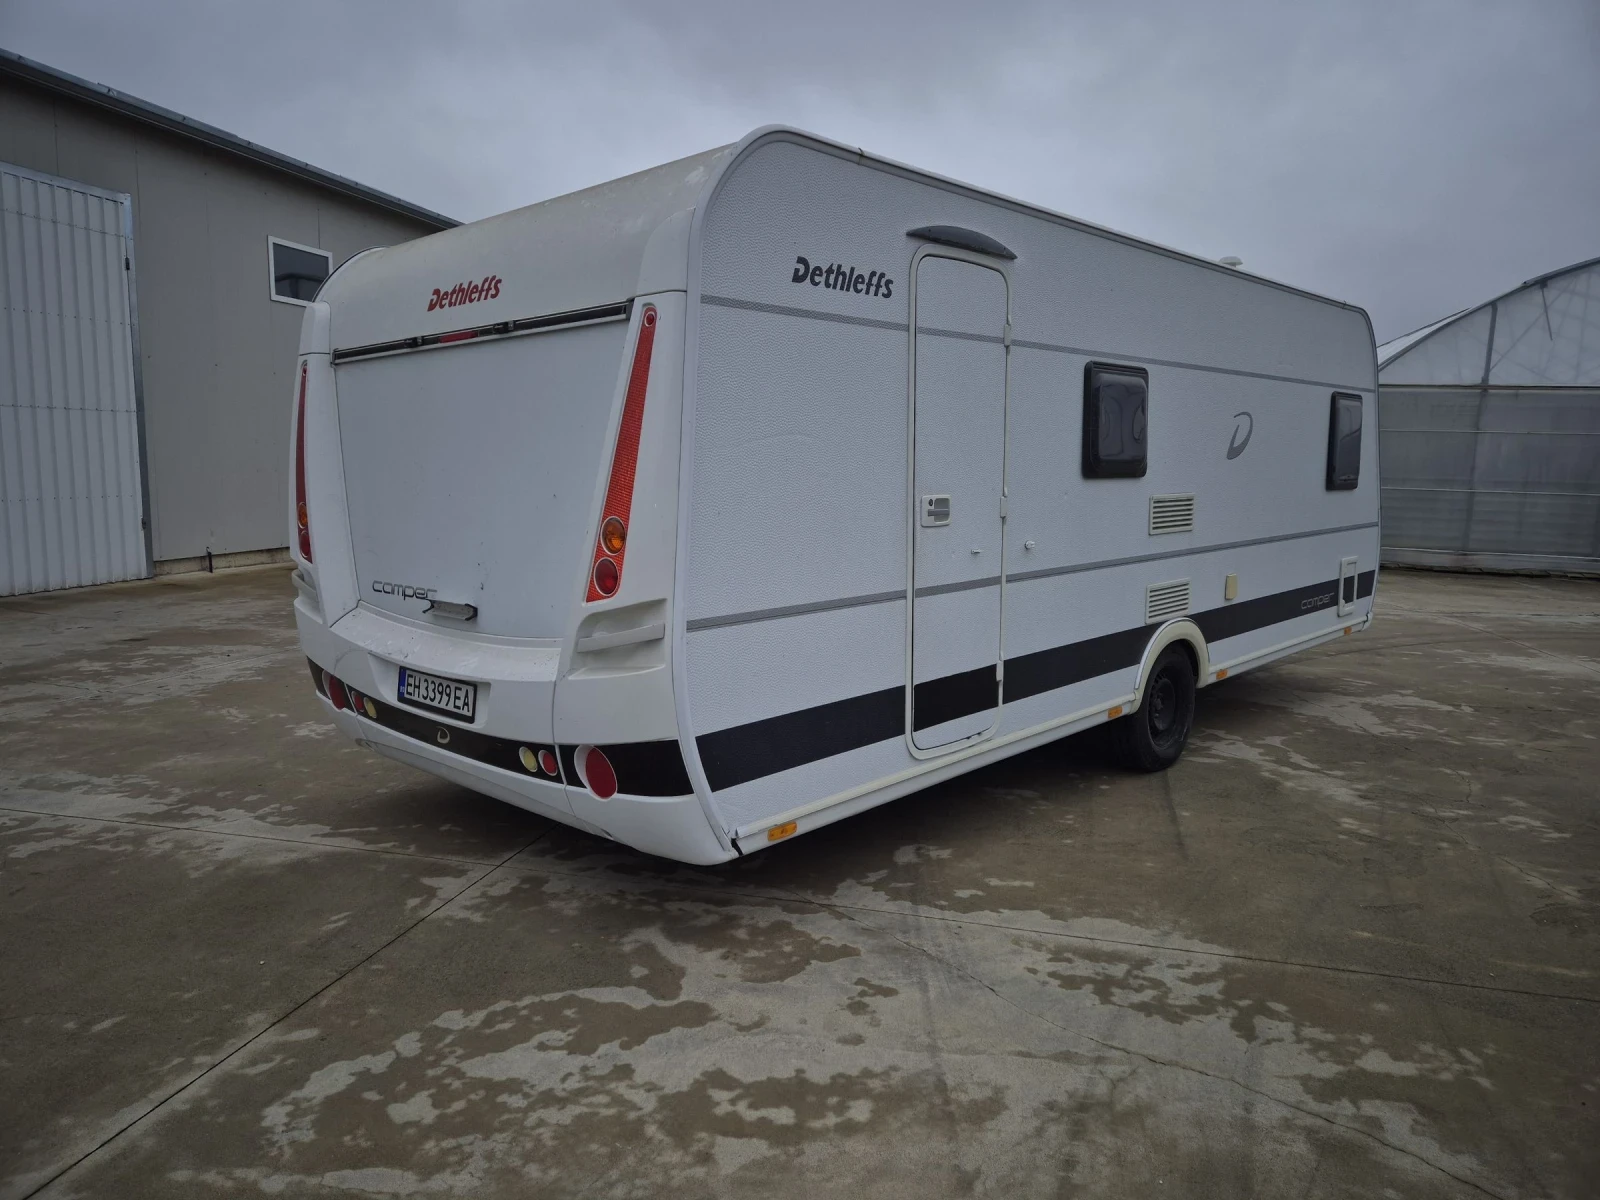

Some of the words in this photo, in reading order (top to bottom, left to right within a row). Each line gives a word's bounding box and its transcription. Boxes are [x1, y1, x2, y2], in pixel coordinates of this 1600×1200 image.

[792, 256, 894, 298] Dethleffs
[427, 275, 502, 312] Dethleffs
[372, 580, 437, 600] camper
[1301, 592, 1335, 609] camper
